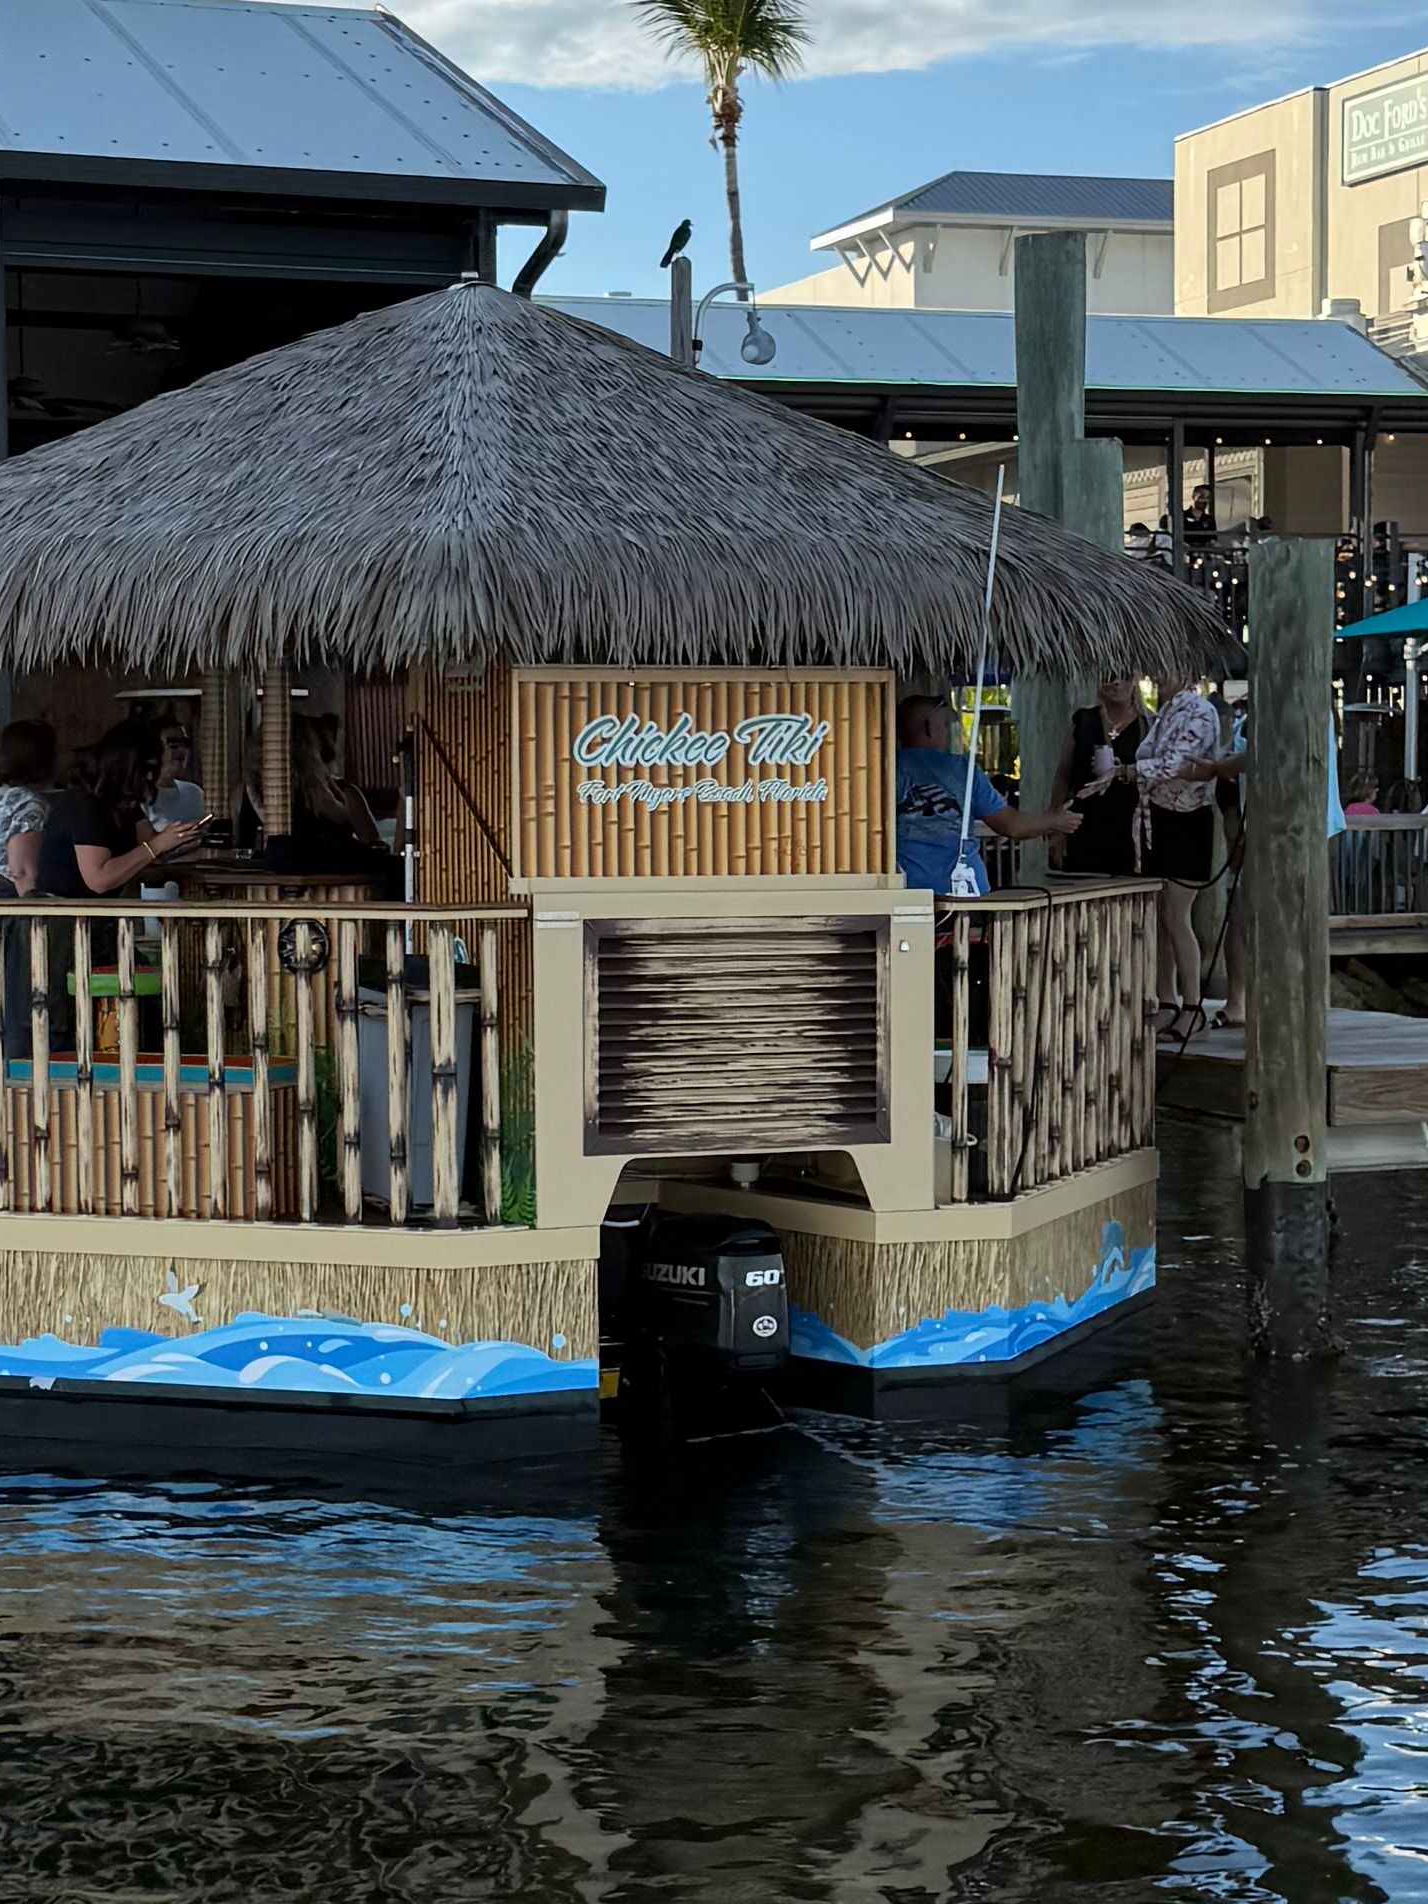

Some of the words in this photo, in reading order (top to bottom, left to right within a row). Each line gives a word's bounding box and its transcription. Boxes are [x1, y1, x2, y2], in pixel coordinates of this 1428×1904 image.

[573, 712, 730, 768] Chickee
[733, 712, 831, 767] Tiki
[745, 1269, 781, 1287] 60
